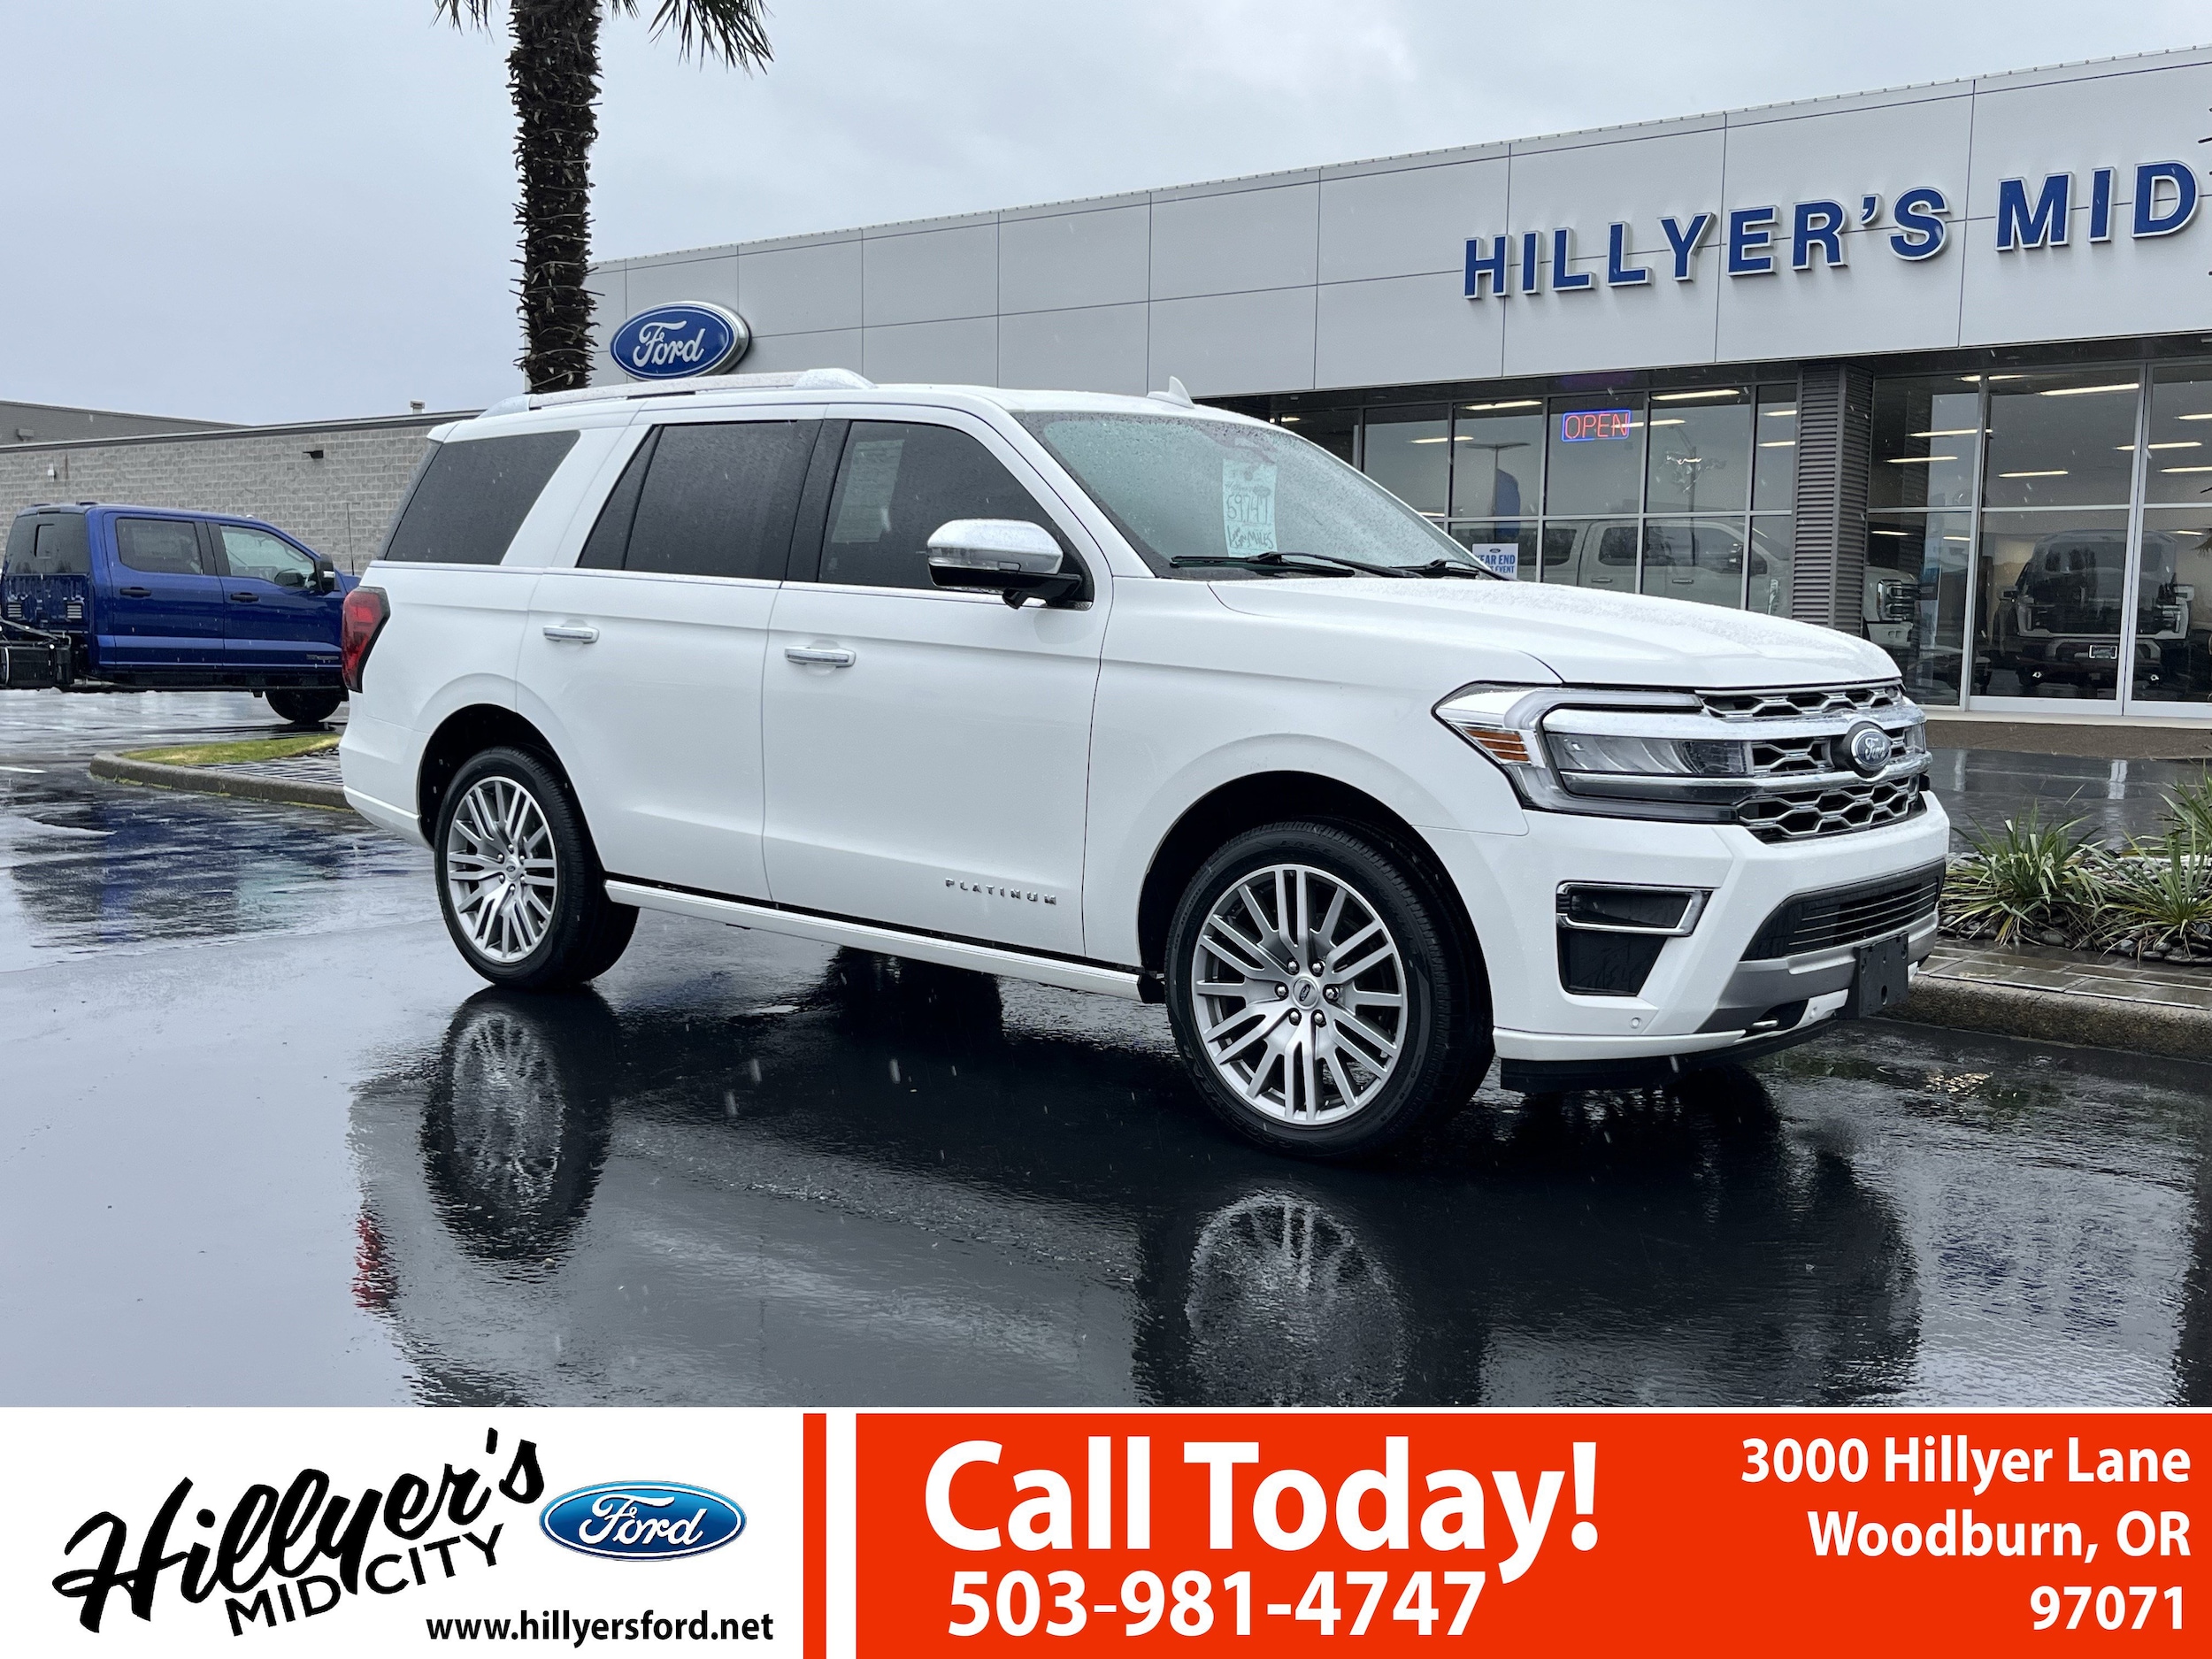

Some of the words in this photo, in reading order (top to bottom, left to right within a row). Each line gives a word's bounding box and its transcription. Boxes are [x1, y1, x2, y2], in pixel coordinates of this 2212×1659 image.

[1464, 186, 1951, 300] HILLYER'S
[1995, 160, 2200, 252] MID
[633, 319, 706, 368] Ford
[1564, 412, 1630, 440] OPEN
[1498, 554, 1516, 565] END
[1864, 737, 1886, 761] Ford
[944, 877, 1057, 906] PLATINUM
